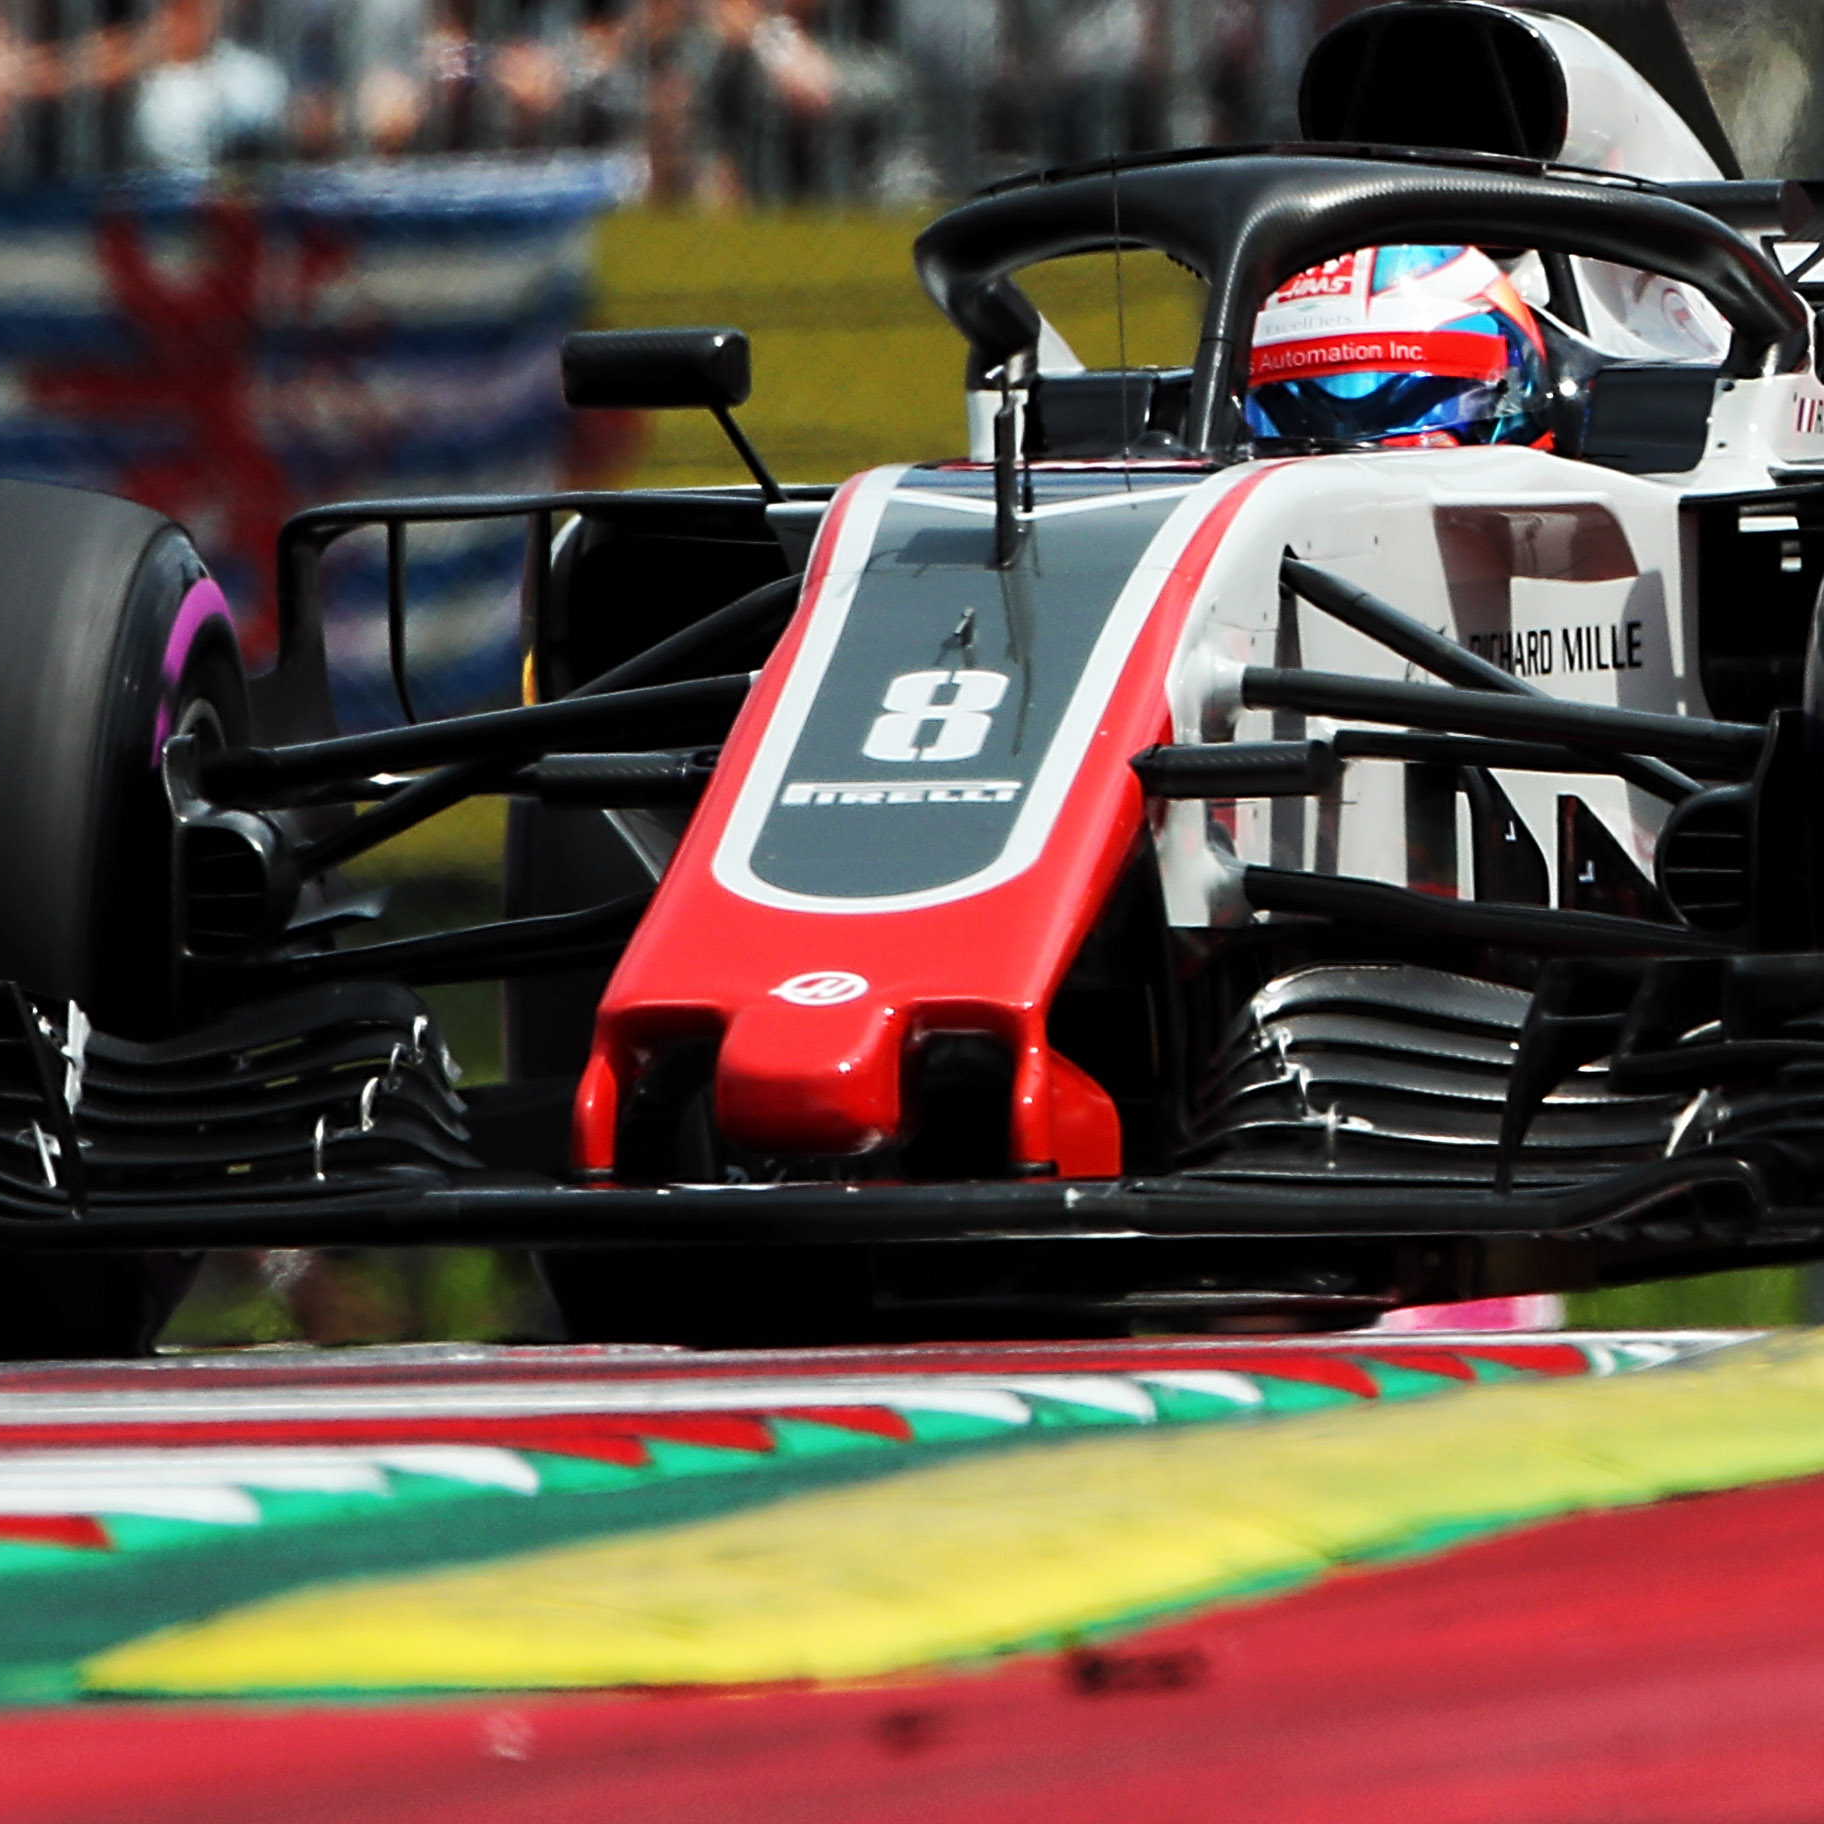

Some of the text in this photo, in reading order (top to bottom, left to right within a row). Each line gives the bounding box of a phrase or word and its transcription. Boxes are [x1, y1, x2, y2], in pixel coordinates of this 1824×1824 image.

[1259, 343, 1382, 371] Automation
[1389, 341, 1428, 361] Inc.
[1562, 620, 1643, 673] MILLE
[862, 670, 1010, 762] 8
[781, 780, 1023, 806] PIRELLI
